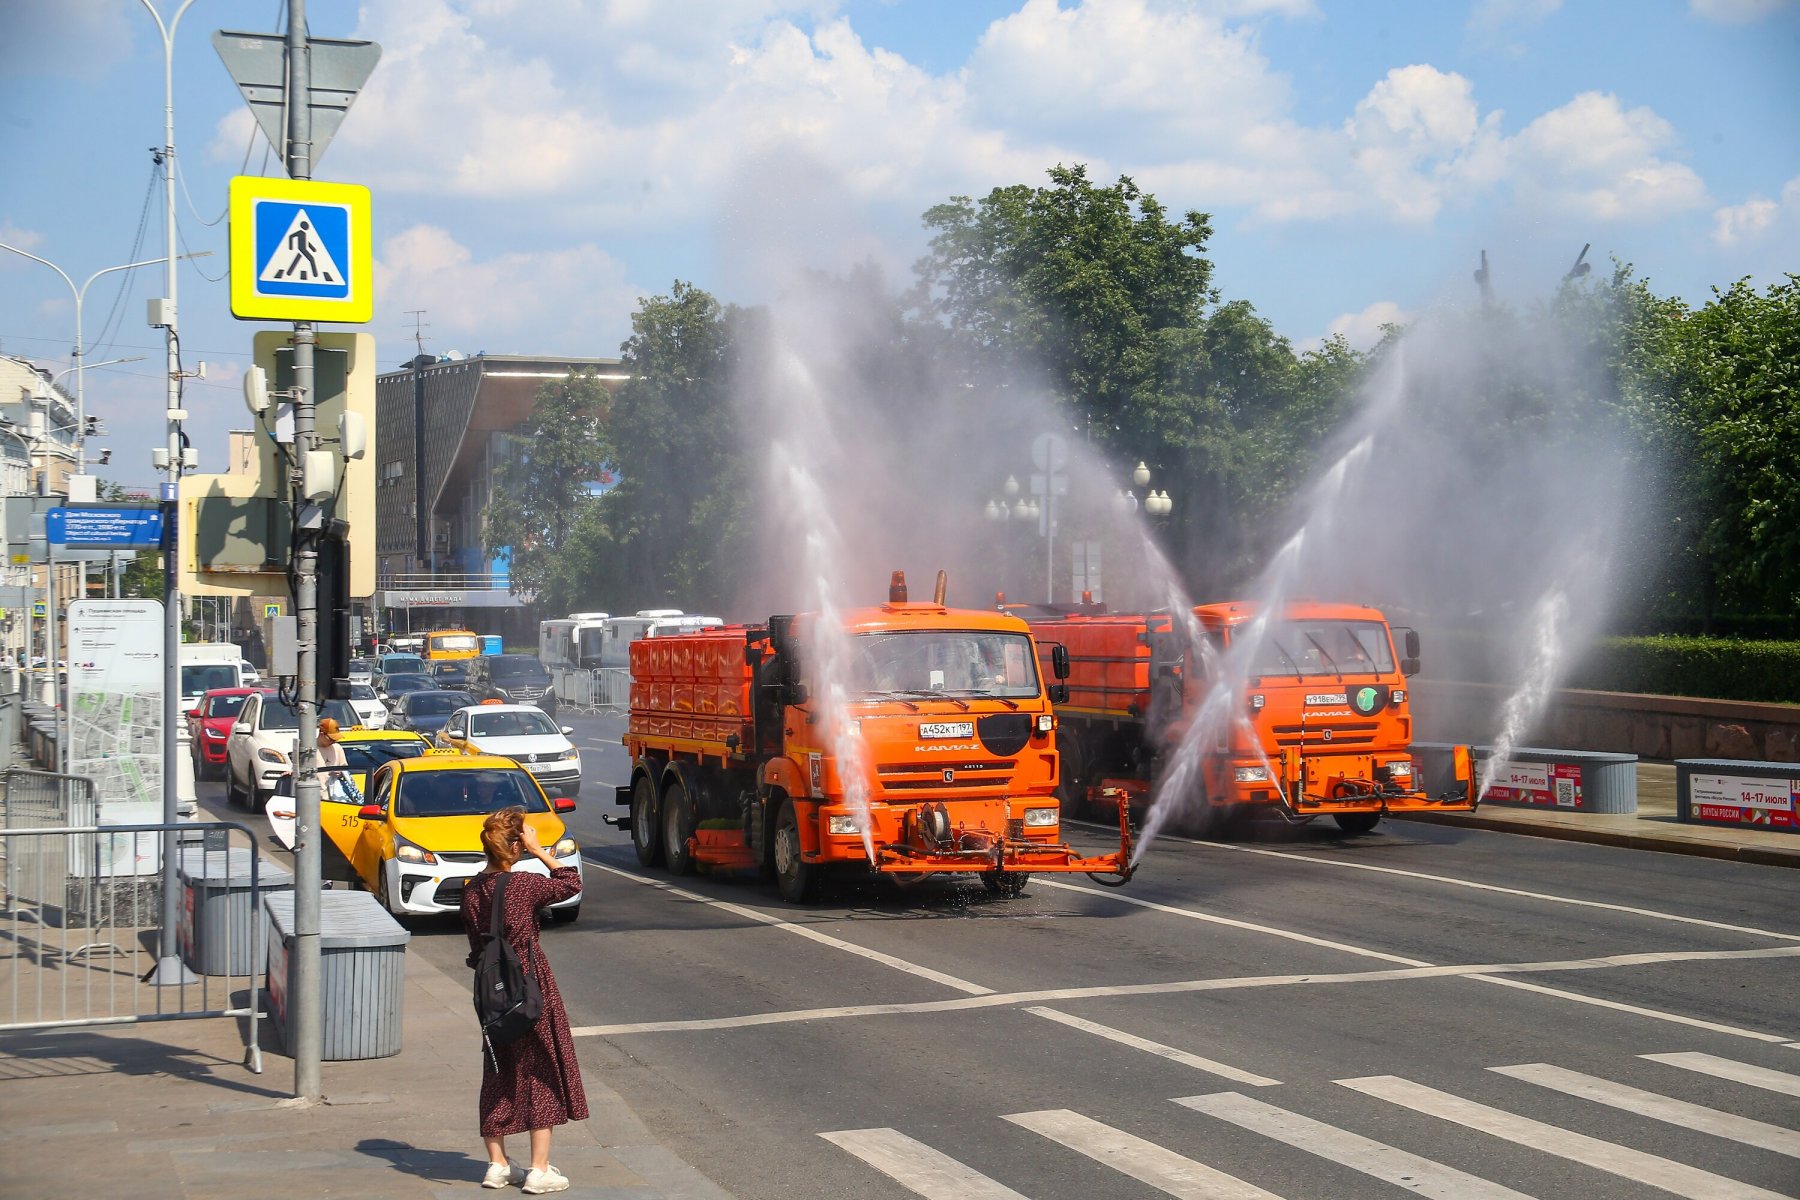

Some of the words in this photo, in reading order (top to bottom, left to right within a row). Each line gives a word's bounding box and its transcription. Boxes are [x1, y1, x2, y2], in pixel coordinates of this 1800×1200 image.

[1741, 791, 1764, 802] 14-17
[1765, 795, 1788, 805] июля
[1702, 807, 1719, 817] ВКУСЫ
[1719, 808, 1740, 818] РОССИИ
[341, 814, 359, 827] 515
